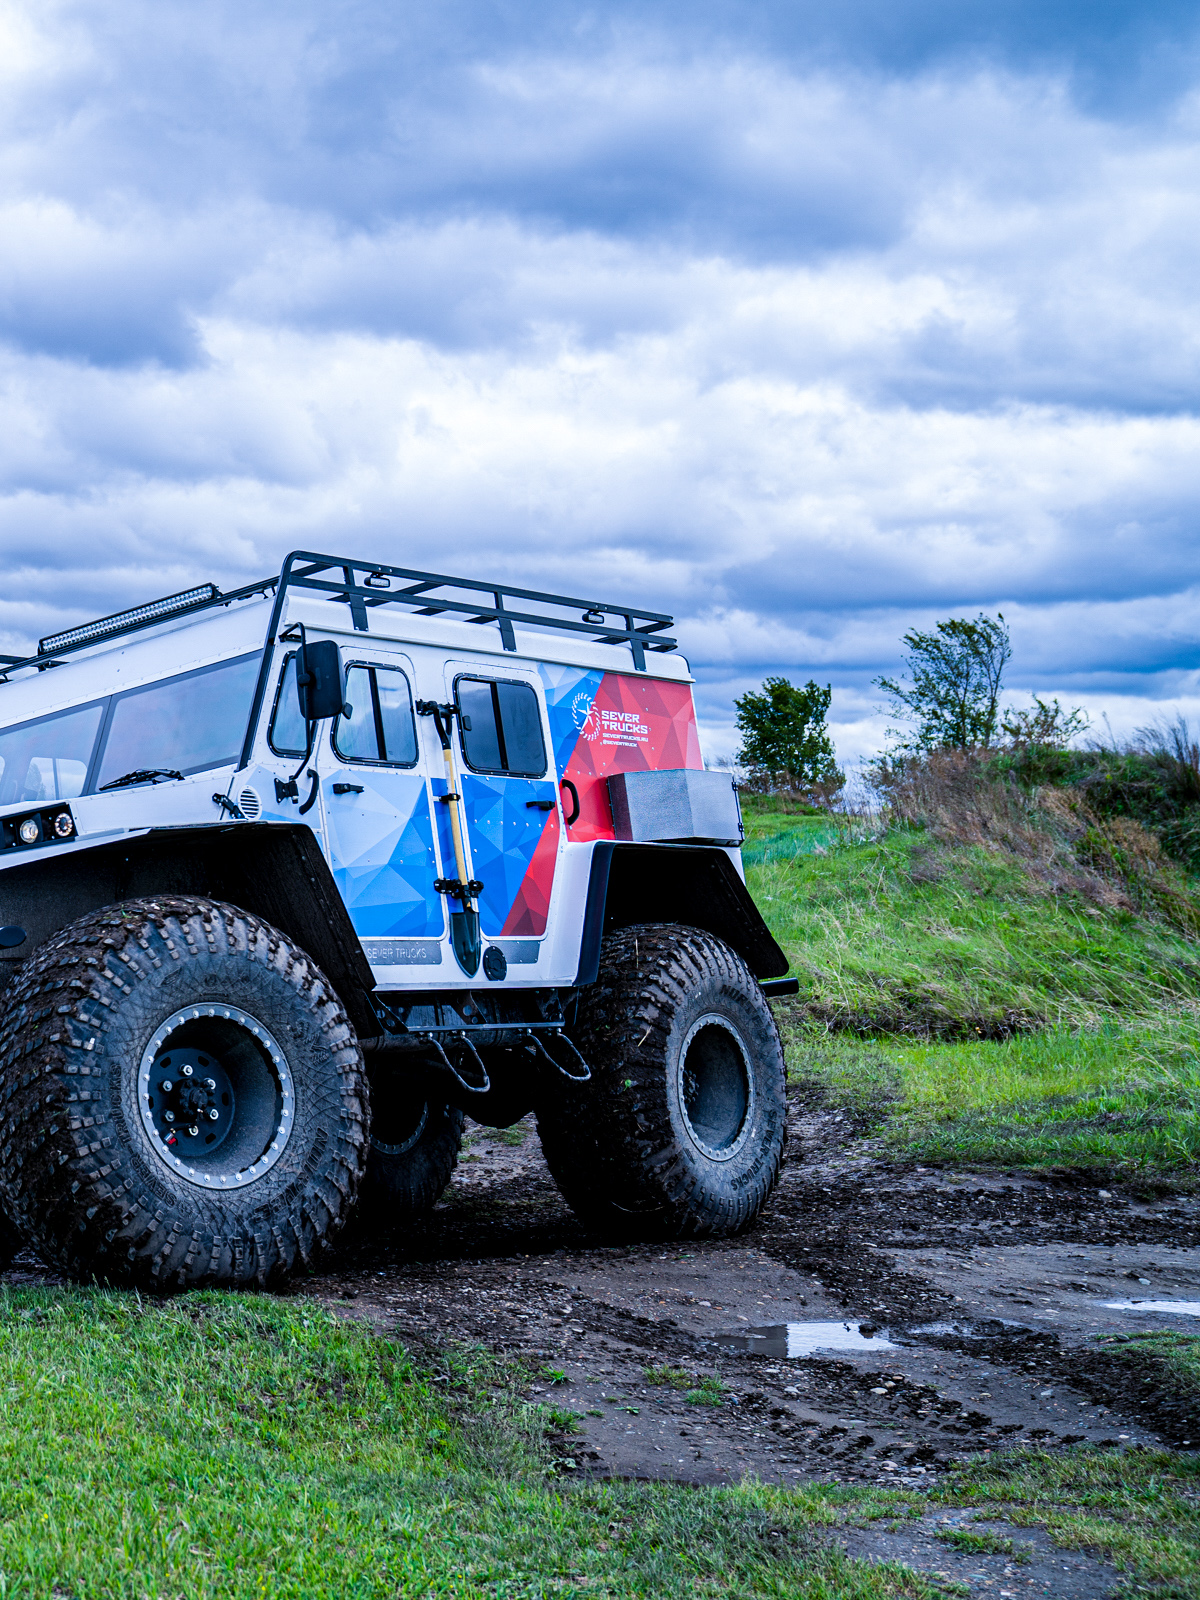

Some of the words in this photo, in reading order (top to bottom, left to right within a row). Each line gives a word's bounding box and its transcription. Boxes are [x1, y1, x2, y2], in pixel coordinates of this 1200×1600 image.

[601, 710, 640, 723] SEVER
[601, 720, 648, 734] TRUCKS
[367, 948, 393, 959] SEVER
[395, 948, 427, 959] TRUCKS
